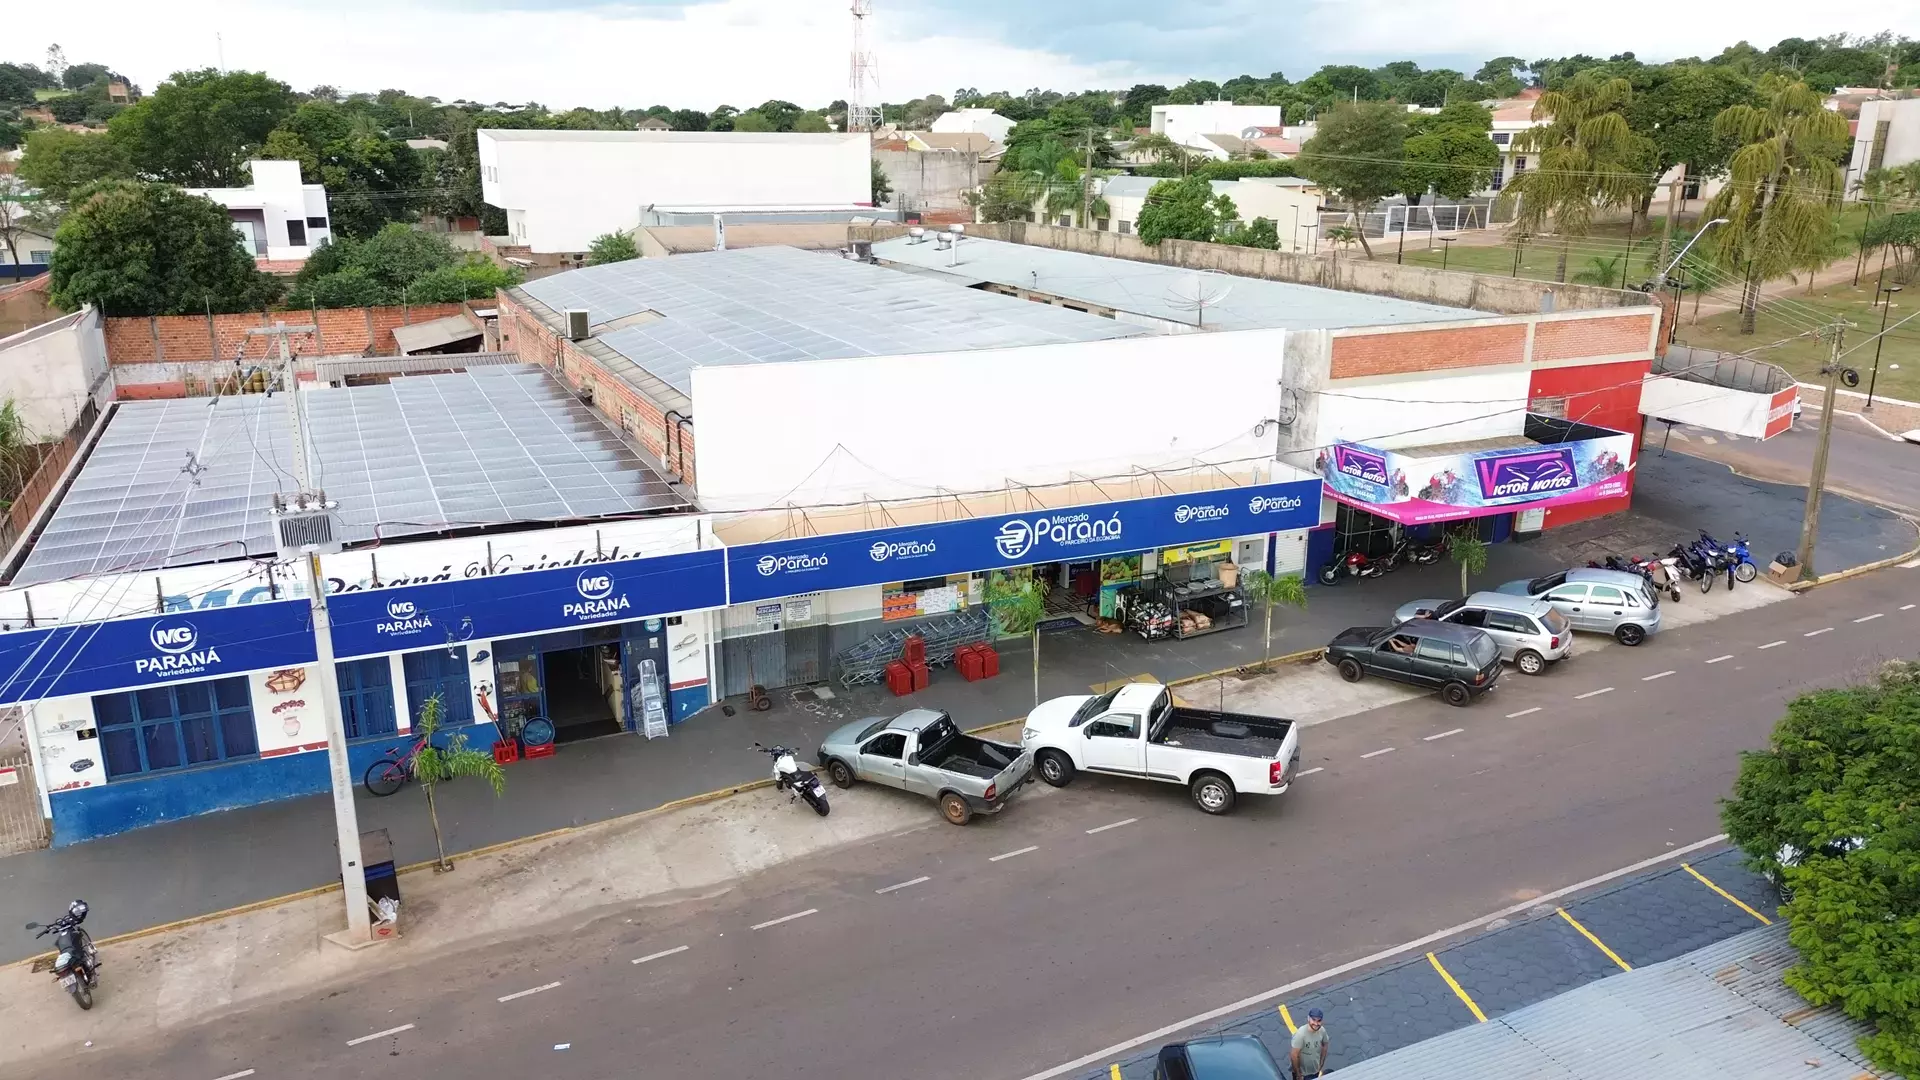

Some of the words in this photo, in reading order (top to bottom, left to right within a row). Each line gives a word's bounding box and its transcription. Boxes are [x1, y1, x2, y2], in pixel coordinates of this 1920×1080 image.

[1362, 471, 1387, 483] MOTOS
[1480, 459, 1530, 496] VICTOR
[1530, 476, 1573, 491] MOTOS
[1190, 503, 1229, 519] Paraná
[1264, 495, 1301, 511] Paraná
[1052, 512, 1089, 525] Mercado
[1034, 511, 1122, 545] Paraná
[889, 539, 936, 557] Paraná
[778, 552, 829, 571] Paraná
[582, 576, 610, 592] MG
[391, 601, 415, 614] MG
[563, 593, 631, 617] PARANÁ
[376, 615, 433, 634] PARANÁ
[578, 611, 617, 621] Variedades
[156, 627, 193, 645] MG
[135, 646, 221, 674] PARANÁ
[156, 666, 205, 677] Variedades
